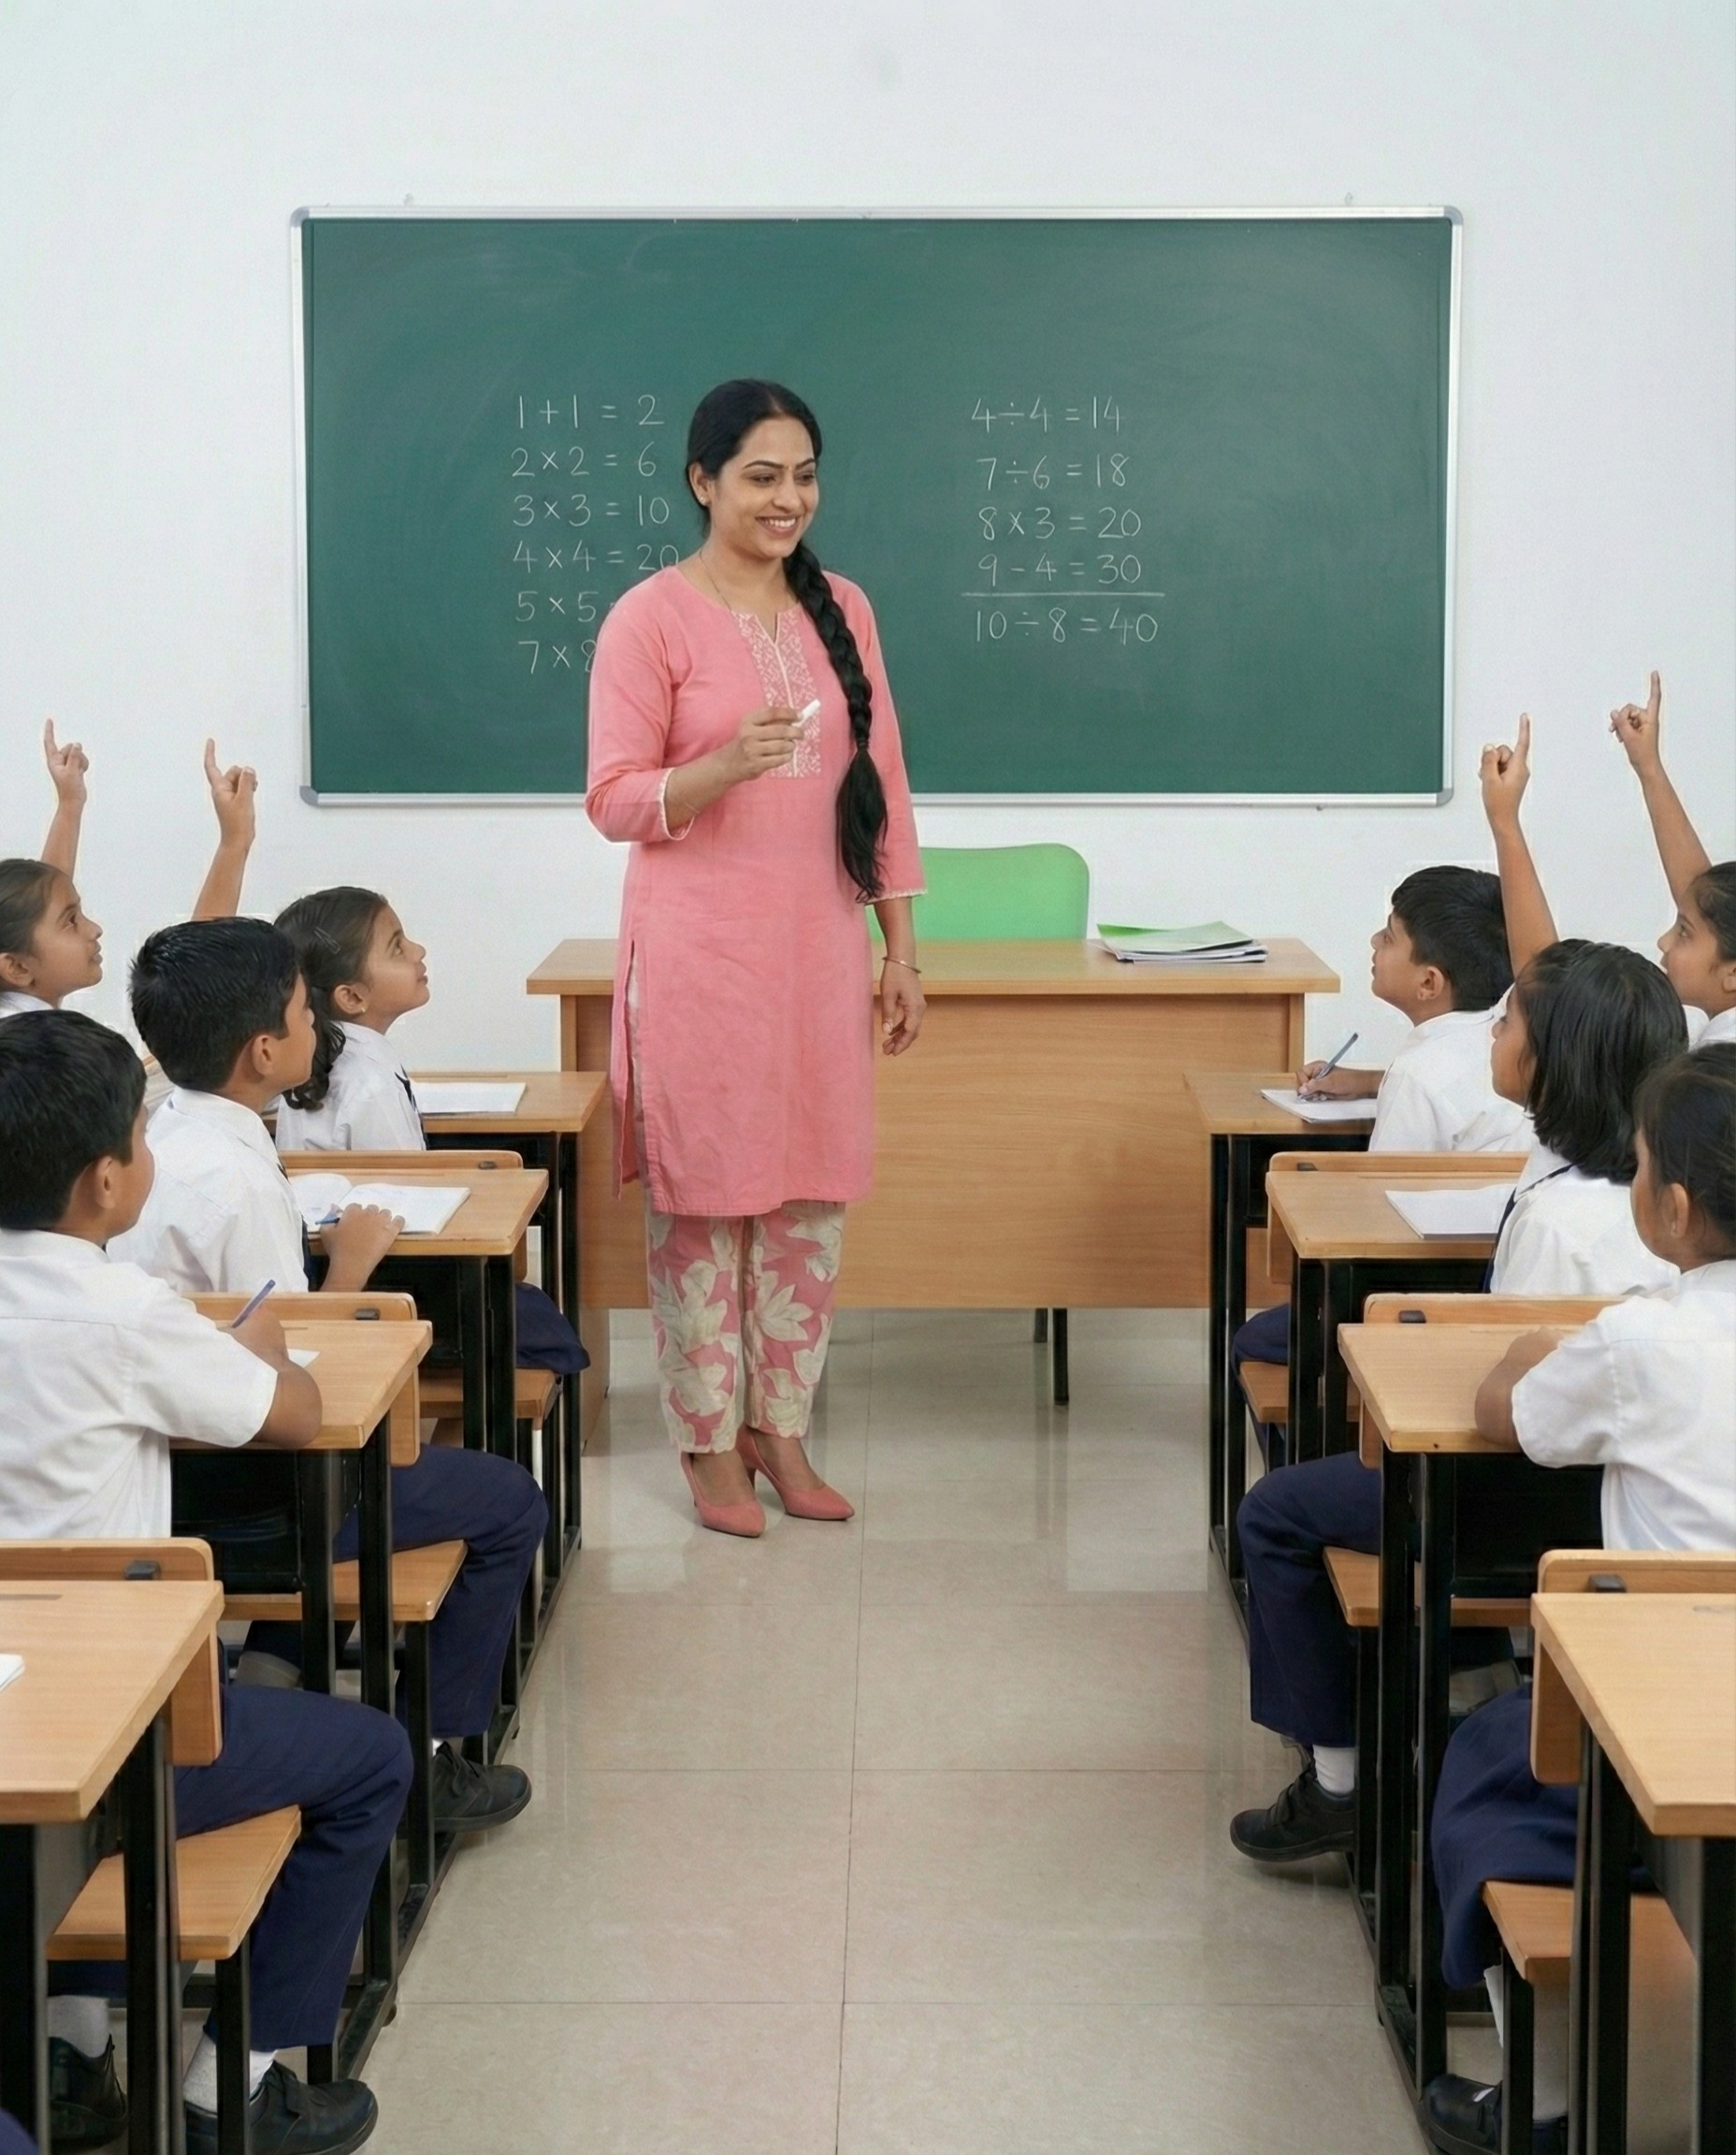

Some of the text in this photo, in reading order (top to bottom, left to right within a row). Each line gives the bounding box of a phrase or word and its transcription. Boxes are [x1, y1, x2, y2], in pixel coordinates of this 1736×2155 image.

[600, 405, 617, 419] =
[637, 394, 665, 427] 2
[1065, 408, 1080, 421] =
[1092, 396, 1124, 433] 14
[603, 454, 618, 467] =
[637, 441, 657, 477] 6
[1066, 463, 1082, 476] =
[1096, 453, 1130, 488] 18
[605, 501, 620, 515] =
[638, 494, 670, 527] 10
[1068, 515, 1088, 530] =
[1097, 506, 1142, 539] 20
[605, 550, 625, 564] =
[636, 543, 679, 571] 20
[1069, 562, 1085, 575] =
[1096, 554, 1142, 585] 30
[1079, 617, 1100, 632] =
[1108, 607, 1159, 646] 40
